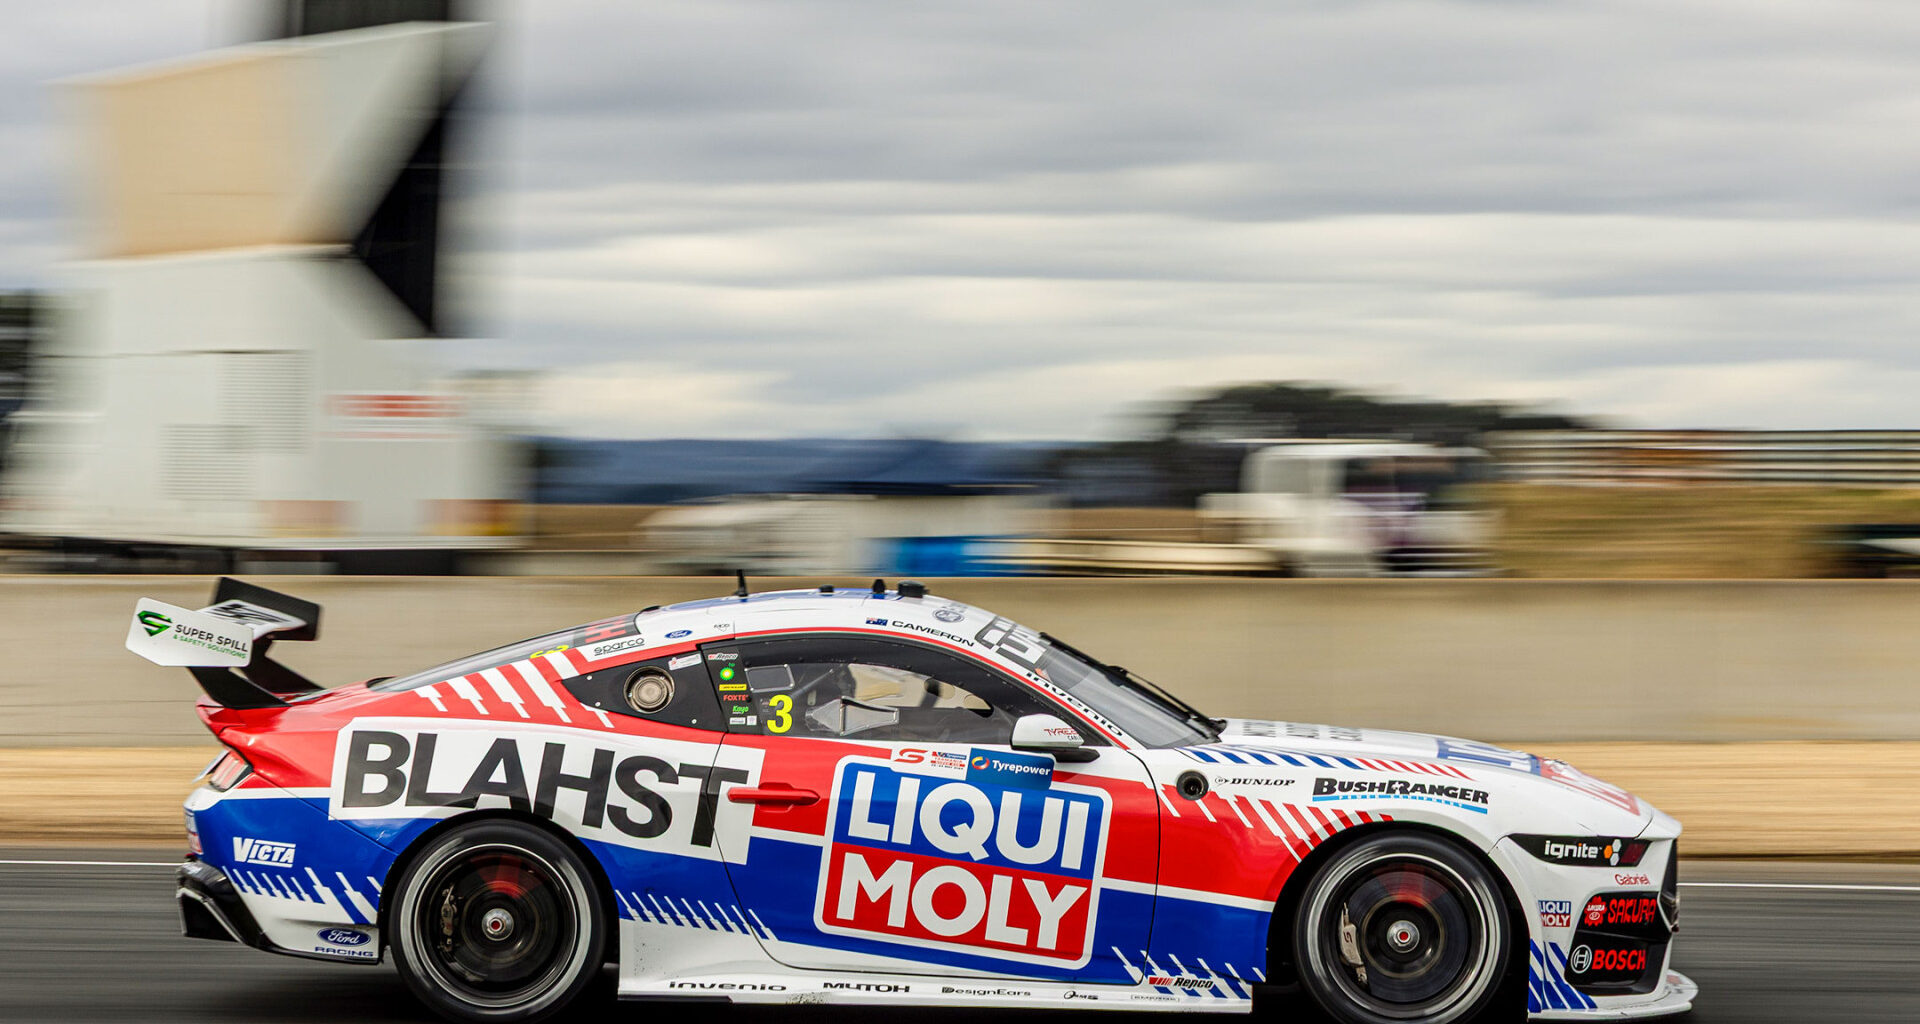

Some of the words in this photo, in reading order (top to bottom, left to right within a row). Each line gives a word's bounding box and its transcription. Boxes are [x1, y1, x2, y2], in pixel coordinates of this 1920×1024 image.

[175, 624, 214, 642] SUPER
[216, 635, 248, 652] SPILL
[892, 620, 974, 647] CAMERON
[180, 635, 206, 648] SAFETY
[207, 643, 247, 659] SOLUTIONS
[594, 638, 645, 654] sparco
[767, 694, 793, 733] 3
[992, 759, 1051, 776] Tyrepower
[342, 730, 749, 848] BLAHST
[1230, 778, 1296, 786] DUNLOP
[848, 770, 1090, 870] LIQUI
[1544, 840, 1599, 859] ignite
[836, 852, 1088, 950] MOLY
[1607, 897, 1657, 924] SAKURA
[326, 929, 362, 946] Ford
[315, 946, 374, 957] RACING
[1591, 950, 1647, 970] BOSCH
[669, 981, 787, 991] invenio
[941, 986, 1031, 996] DesignEars
[1173, 977, 1214, 989] Repco
